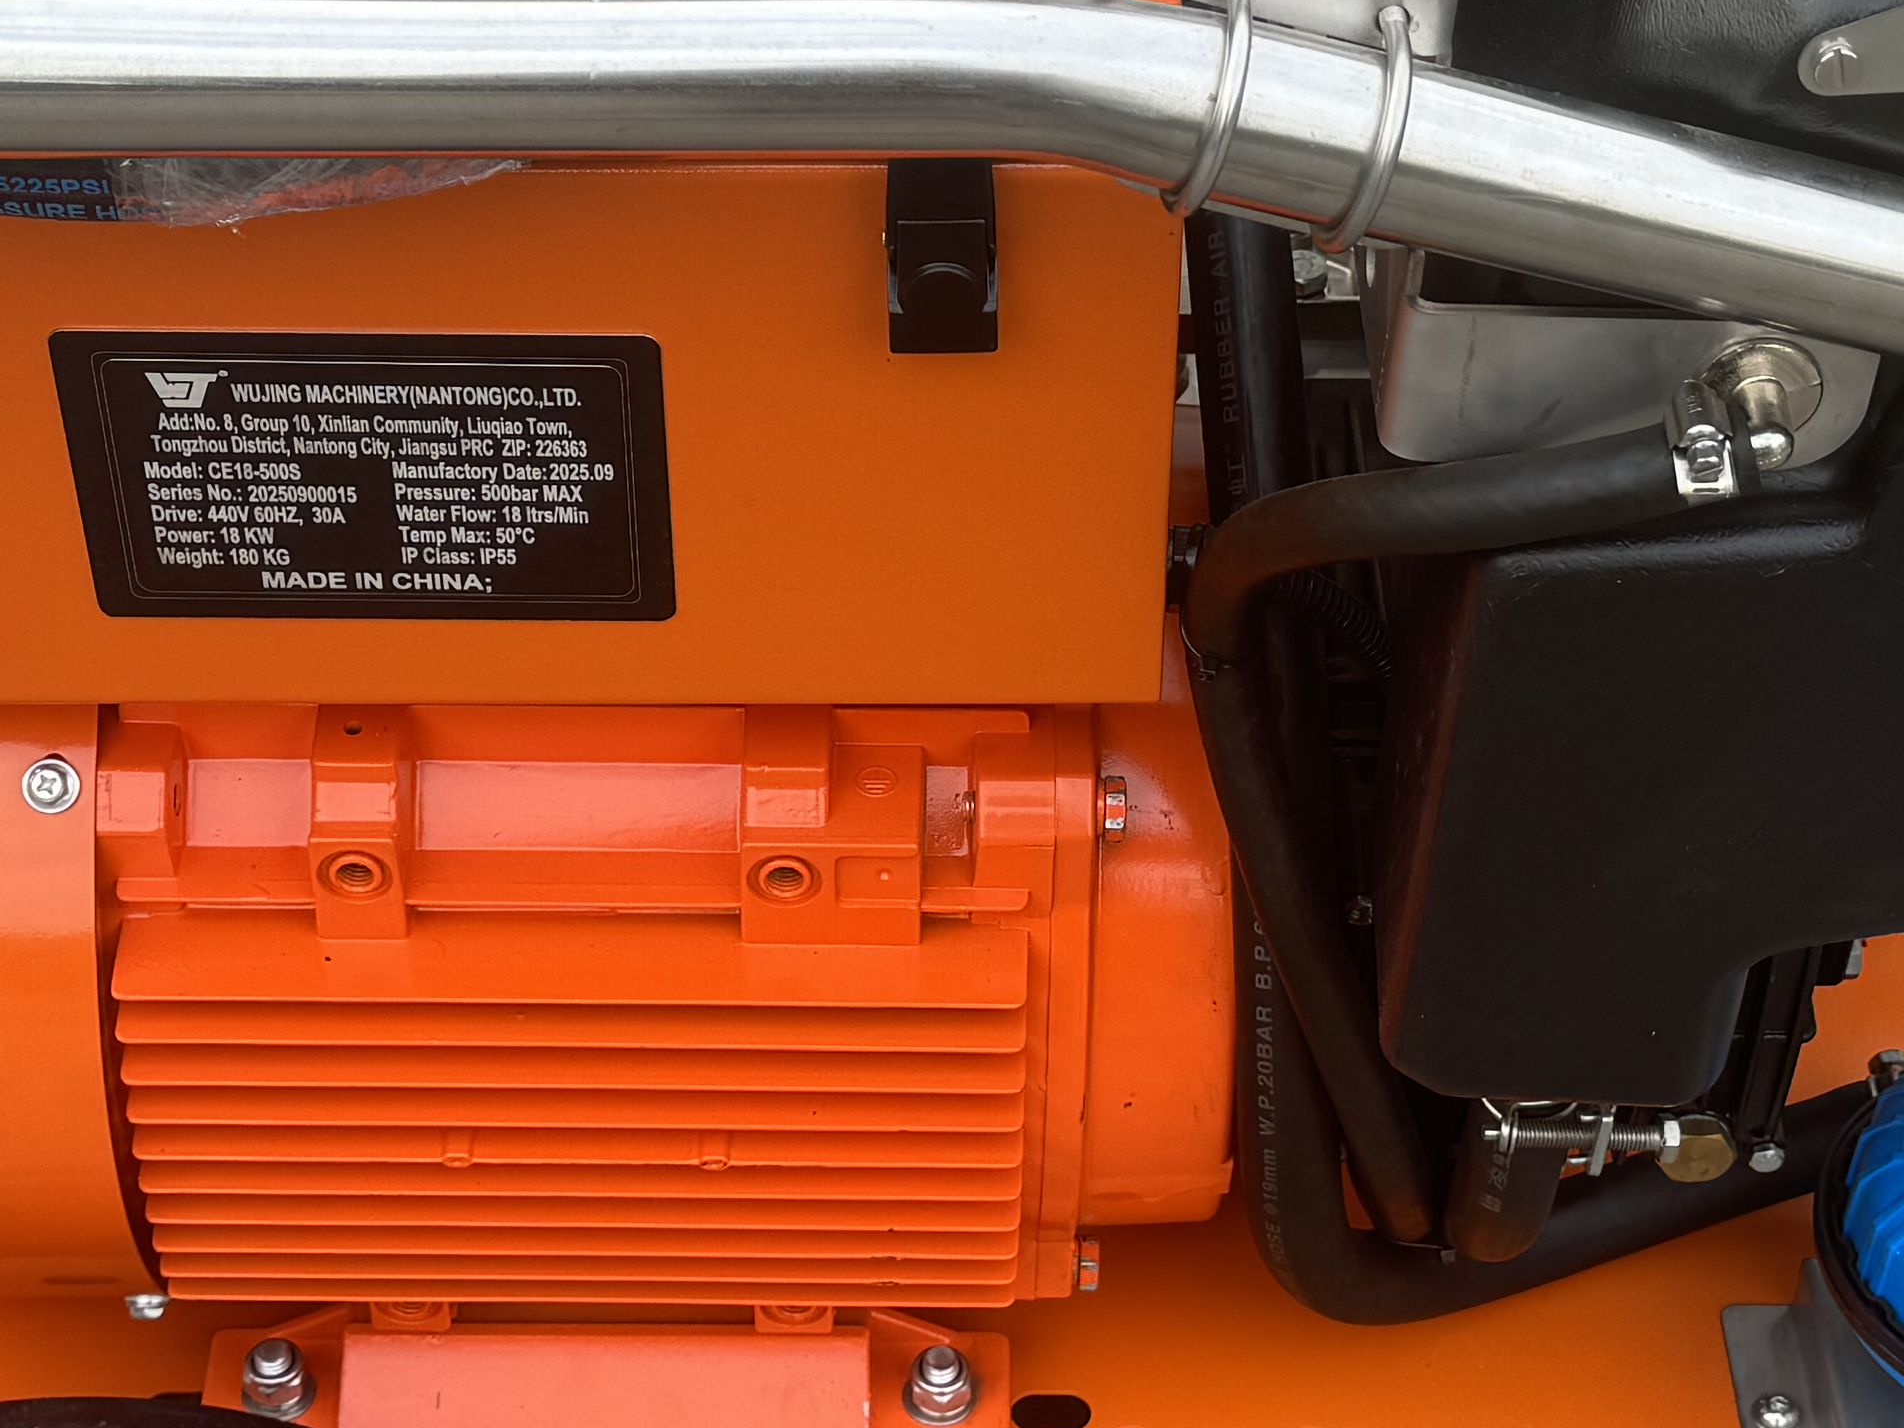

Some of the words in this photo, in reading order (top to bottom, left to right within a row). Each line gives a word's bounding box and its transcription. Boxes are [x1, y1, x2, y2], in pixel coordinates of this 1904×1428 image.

[231, 383, 301, 403] WUJING
[306, 385, 581, 409] MACHINERY(NANTONG)CO.,LTD.
[159, 413, 220, 431] Add:No.
[224, 414, 238, 434] 8,
[242, 414, 288, 435] Group
[293, 415, 315, 435] 10,
[319, 415, 369, 433] Xinlian
[374, 415, 464, 438] Community,
[467, 417, 522, 438] Liuqiao
[526, 418, 572, 438] Town,
[151, 435, 227, 457] Tongzhou
[231, 436, 290, 457] District,
[294, 436, 357, 458] Nantong
[361, 437, 395, 459] City,
[399, 438, 457, 460] Jiangsu
[461, 439, 493, 457] PRC
[502, 439, 531, 457] ZIP:
[536, 440, 587, 457] 226363
[144, 462, 203, 479] Model:
[208, 462, 301, 480] CE18-500S
[392, 462, 497, 483] Manufactory
[503, 463, 546, 481] Date:
[550, 464, 614, 481] 2025.09
[148, 483, 203, 501] Series
[207, 485, 242, 502] No.:
[248, 485, 357, 503] 20250900015
[395, 483, 476, 501] Pressure:
[482, 485, 538, 502] 500bar
[543, 485, 583, 502] MAX
[151, 505, 203, 522] Drive:
[208, 505, 249, 523] 440V
[254, 506, 303, 526] 60HZ,
[312, 507, 345, 523] 30A
[396, 505, 446, 522] Water
[451, 506, 496, 523] Flow:
[502, 506, 521, 523] 18
[527, 507, 589, 524] ltrs/Min
[154, 526, 215, 544] Power:
[221, 527, 240, 544] 18
[245, 528, 274, 544] KW
[399, 526, 446, 546] Temp
[451, 527, 490, 544] Max:
[496, 528, 535, 544] 50°C
[157, 547, 224, 568] Weight:
[230, 548, 259, 565] 180
[263, 549, 290, 565] KG
[402, 547, 418, 564] IP
[423, 547, 475, 564] Class:
[480, 548, 516, 565] IP55
[262, 572, 347, 589] MADE
[355, 572, 383, 589] IN
[392, 573, 492, 593] CHINA;
[1256, 1005, 1276, 1136] W.P.20BAR
